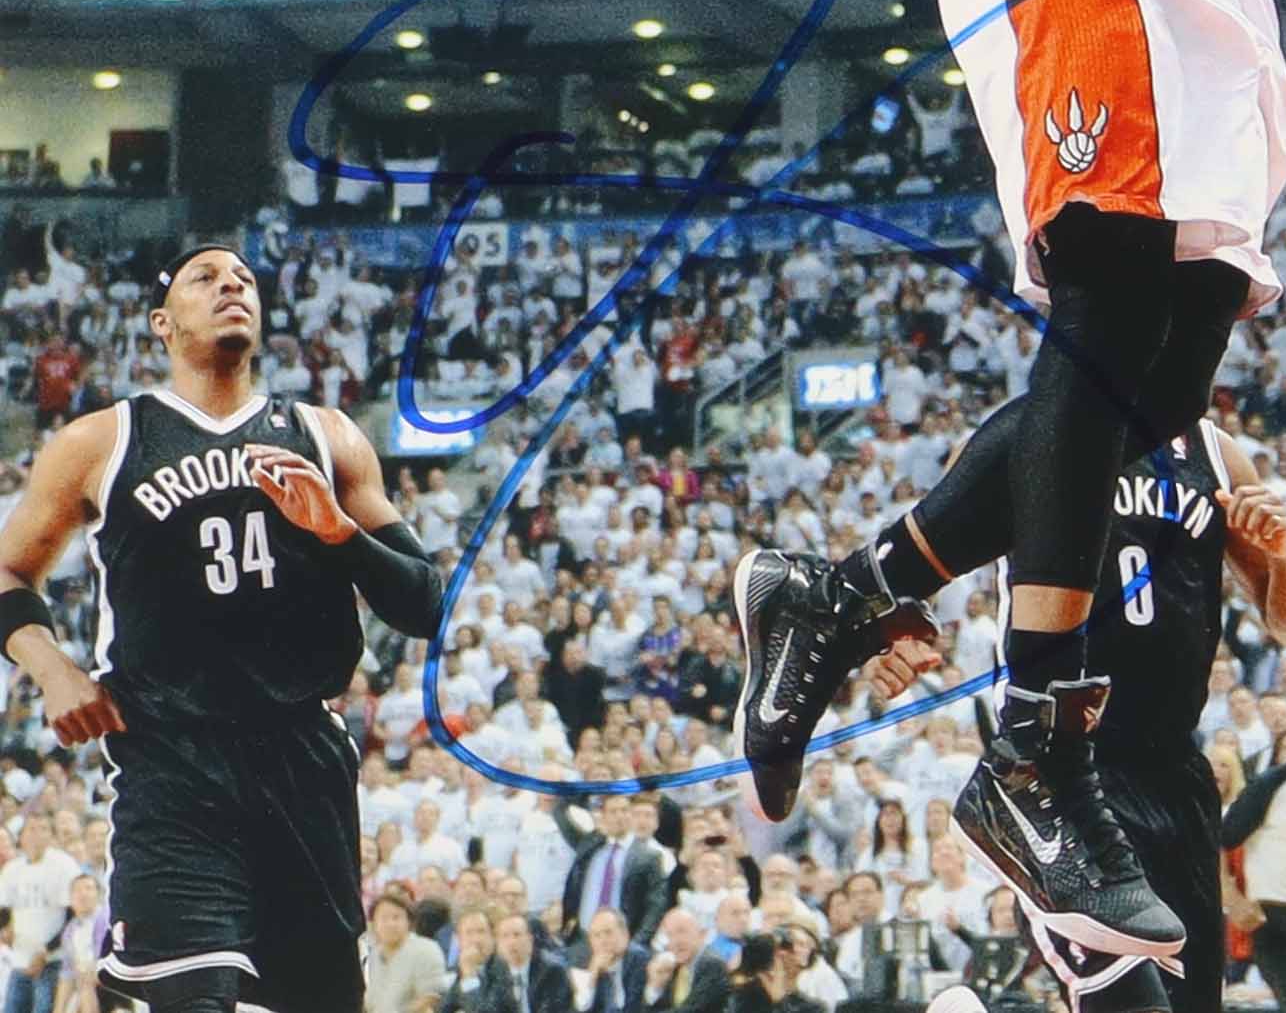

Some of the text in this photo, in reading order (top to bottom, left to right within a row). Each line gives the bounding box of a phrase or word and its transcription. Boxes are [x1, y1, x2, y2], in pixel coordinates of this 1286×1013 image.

[133, 447, 266, 522] BROOK
[1113, 475, 1215, 539] OKLYN
[200, 510, 277, 595] 34
[1118, 545, 1155, 626] 0
